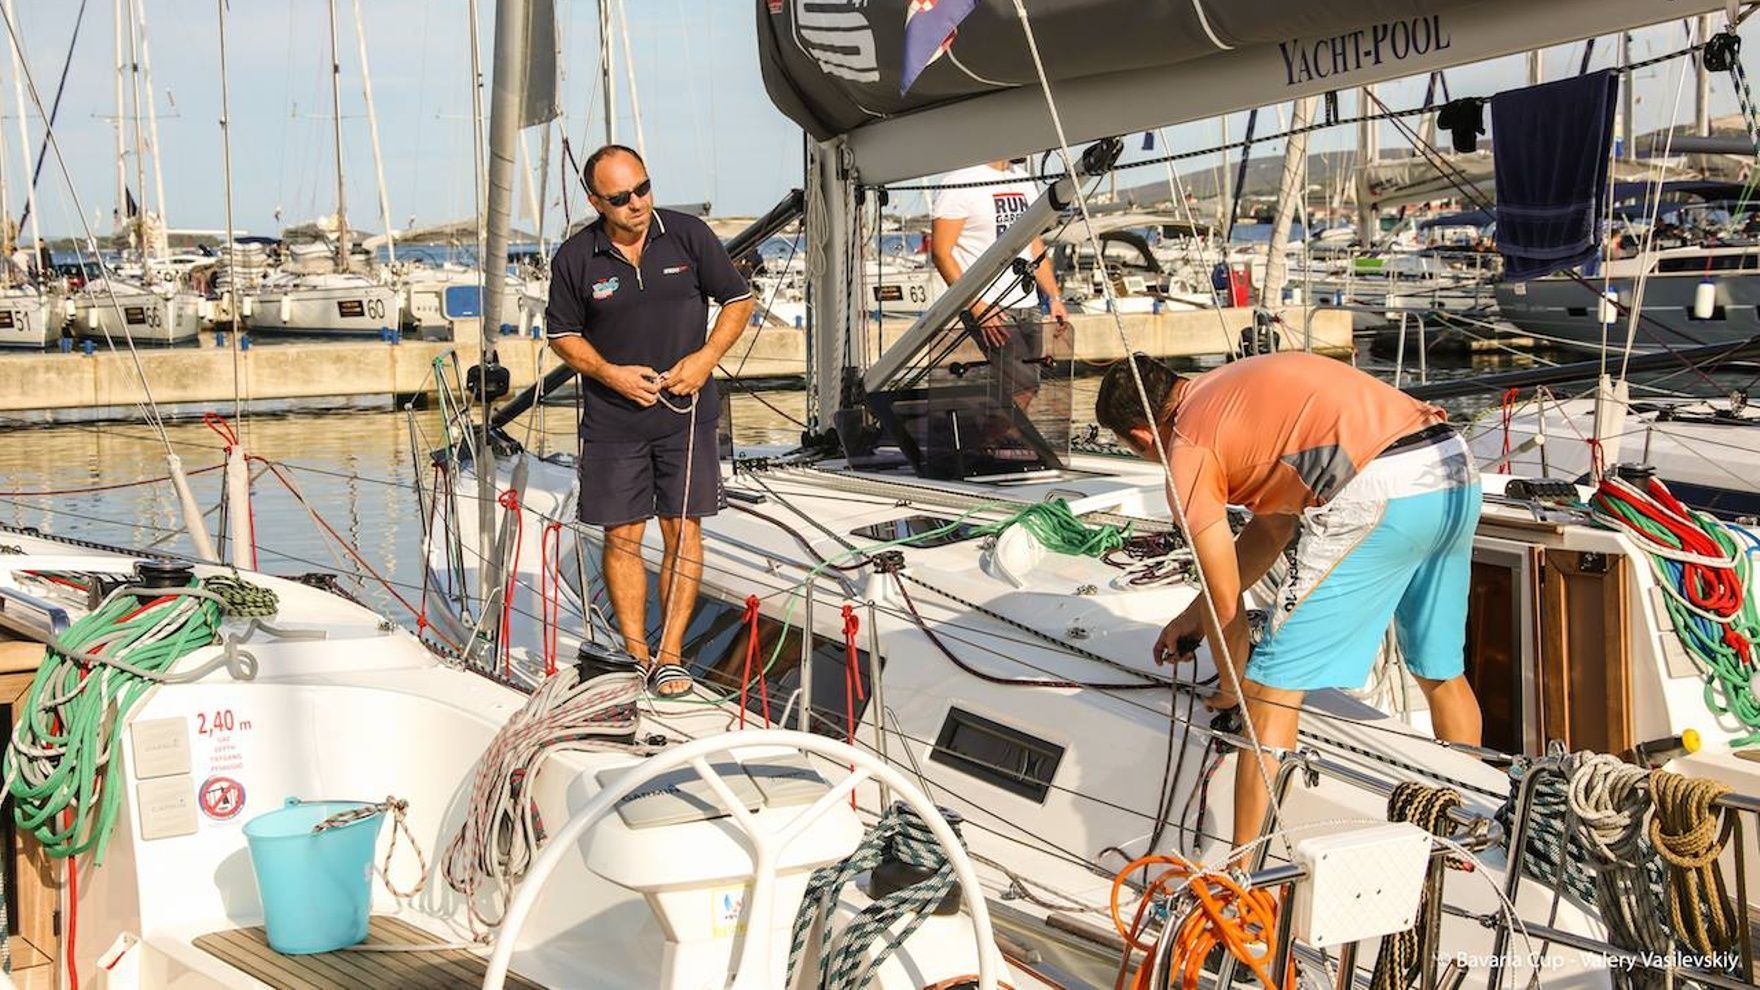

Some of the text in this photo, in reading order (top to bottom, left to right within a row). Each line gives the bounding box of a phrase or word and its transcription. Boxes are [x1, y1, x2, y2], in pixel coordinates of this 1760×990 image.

[1279, 15, 1450, 85] YACHT-POOL
[994, 197, 1028, 213] RUN
[910, 285, 926, 303] 63
[146, 306, 162, 328] 66
[367, 298, 385, 319] 60
[14, 310, 31, 332] 51
[197, 709, 252, 738] 2,40 m
